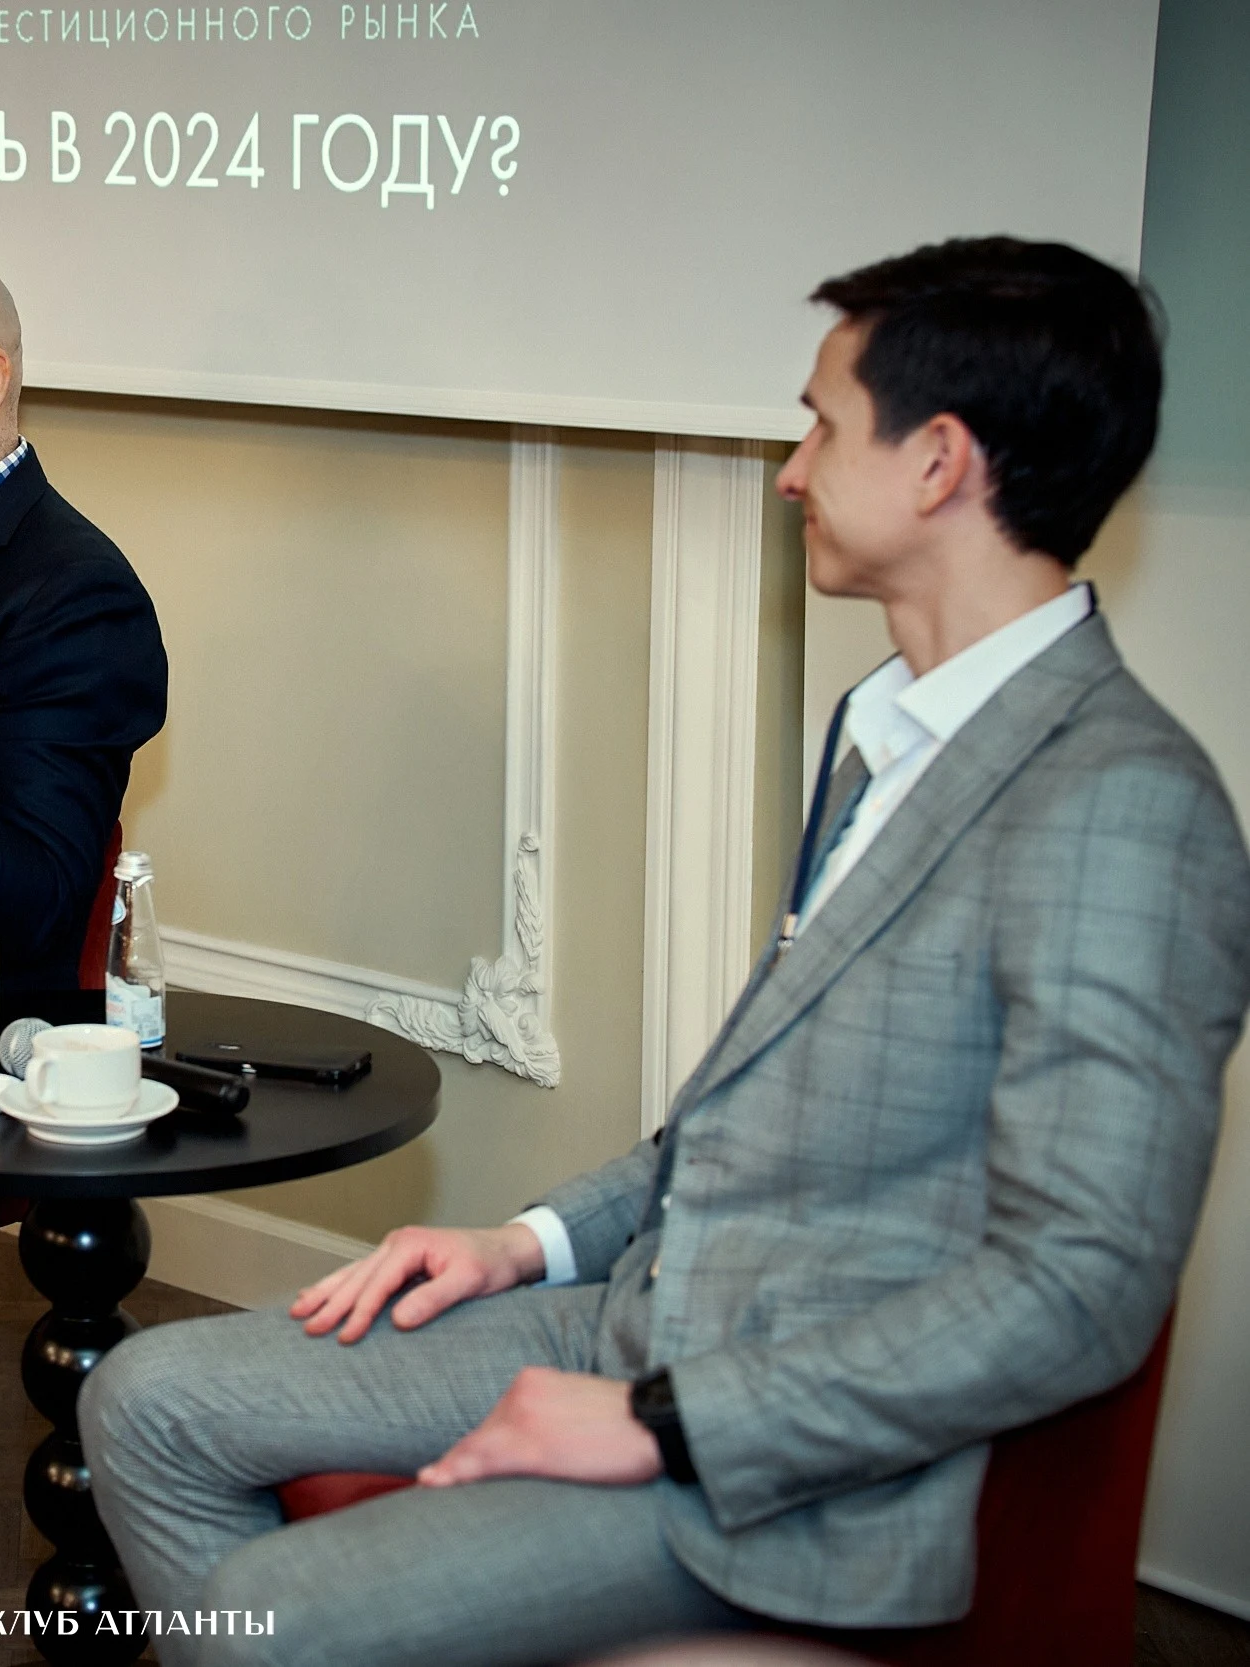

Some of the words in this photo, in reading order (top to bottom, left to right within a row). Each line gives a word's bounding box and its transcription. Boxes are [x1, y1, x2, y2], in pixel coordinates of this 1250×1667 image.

[340, 3, 480, 41] РЫНКА
[50, 110, 81, 184] В
[104, 110, 265, 189] 2024
[292, 113, 521, 211] ГОДУ?
